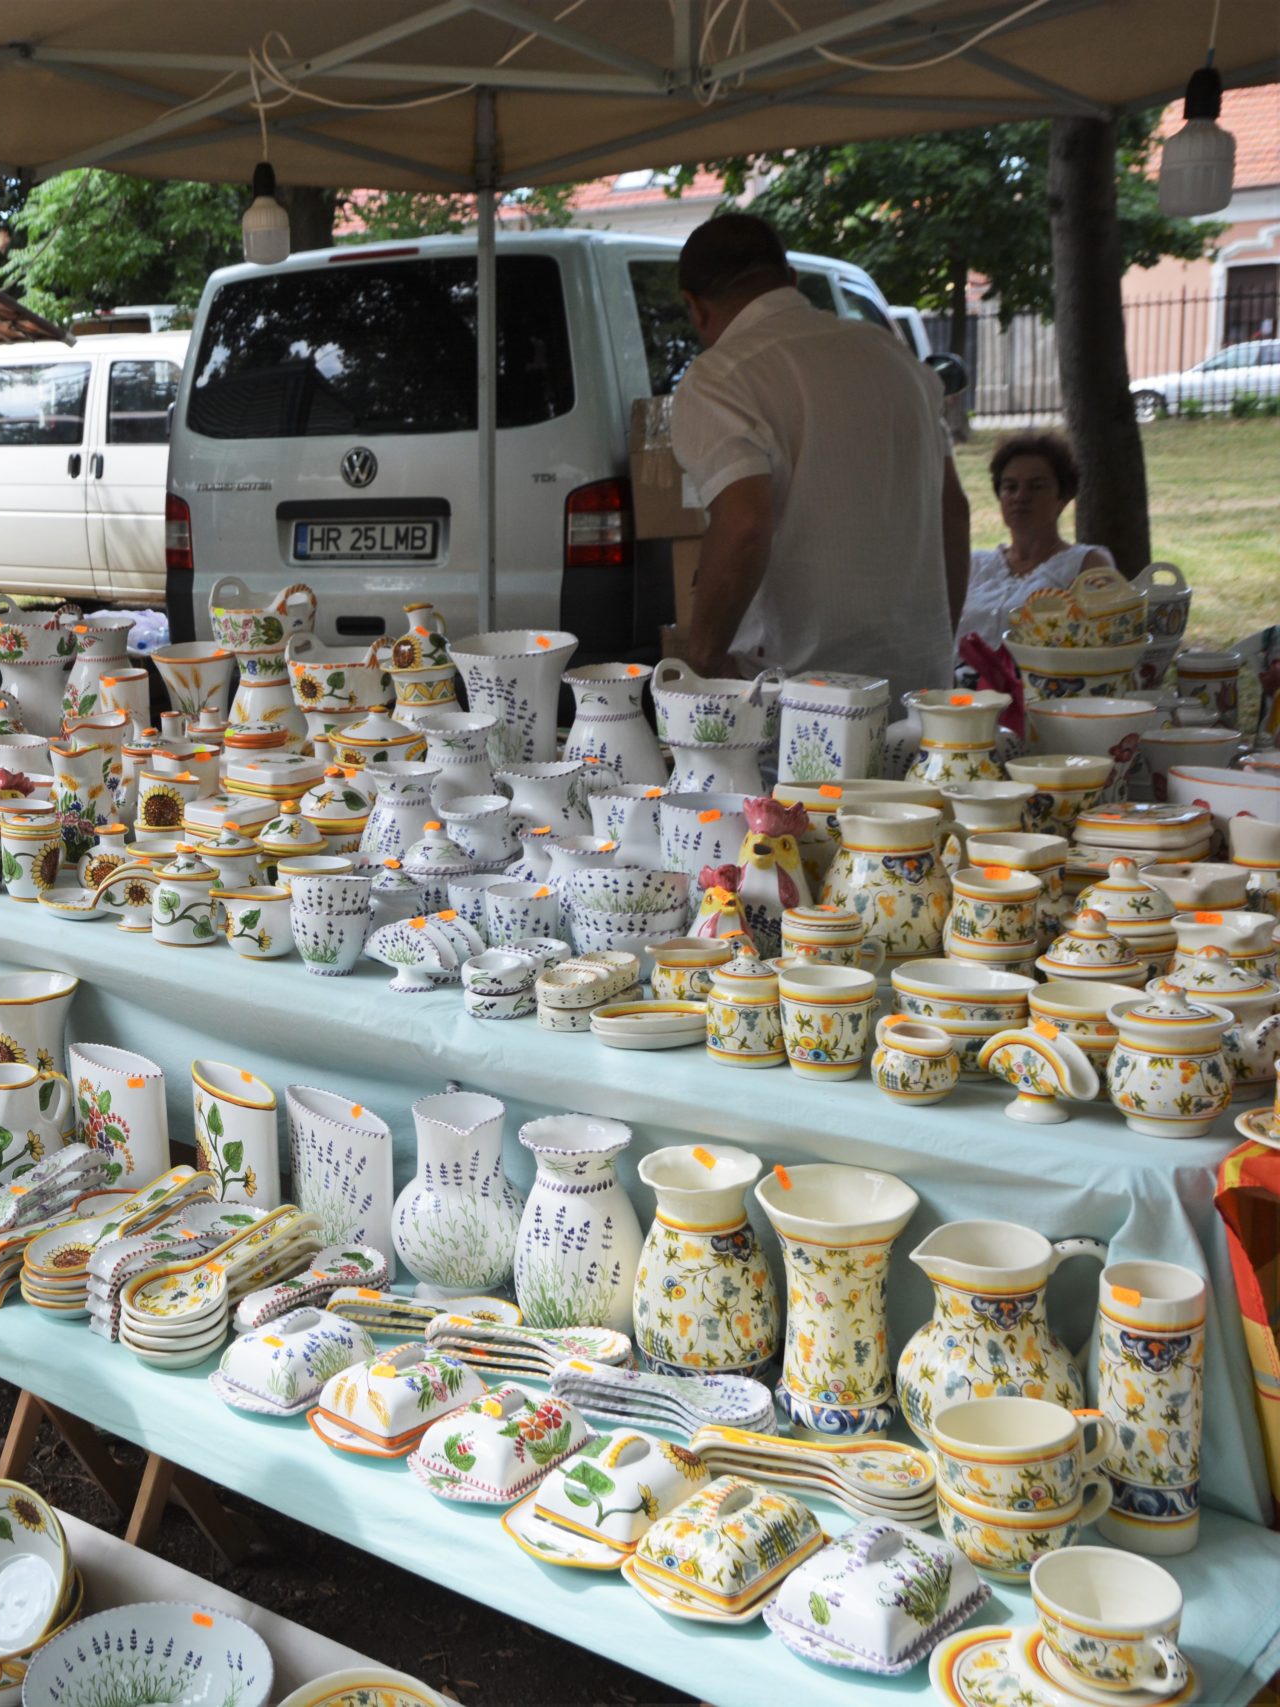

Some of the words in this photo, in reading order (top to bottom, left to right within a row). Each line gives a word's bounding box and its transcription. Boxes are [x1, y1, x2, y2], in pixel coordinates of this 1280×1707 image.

[309, 526, 342, 552] HR
[349, 526, 377, 551] 25
[380, 525, 428, 551] LMB
